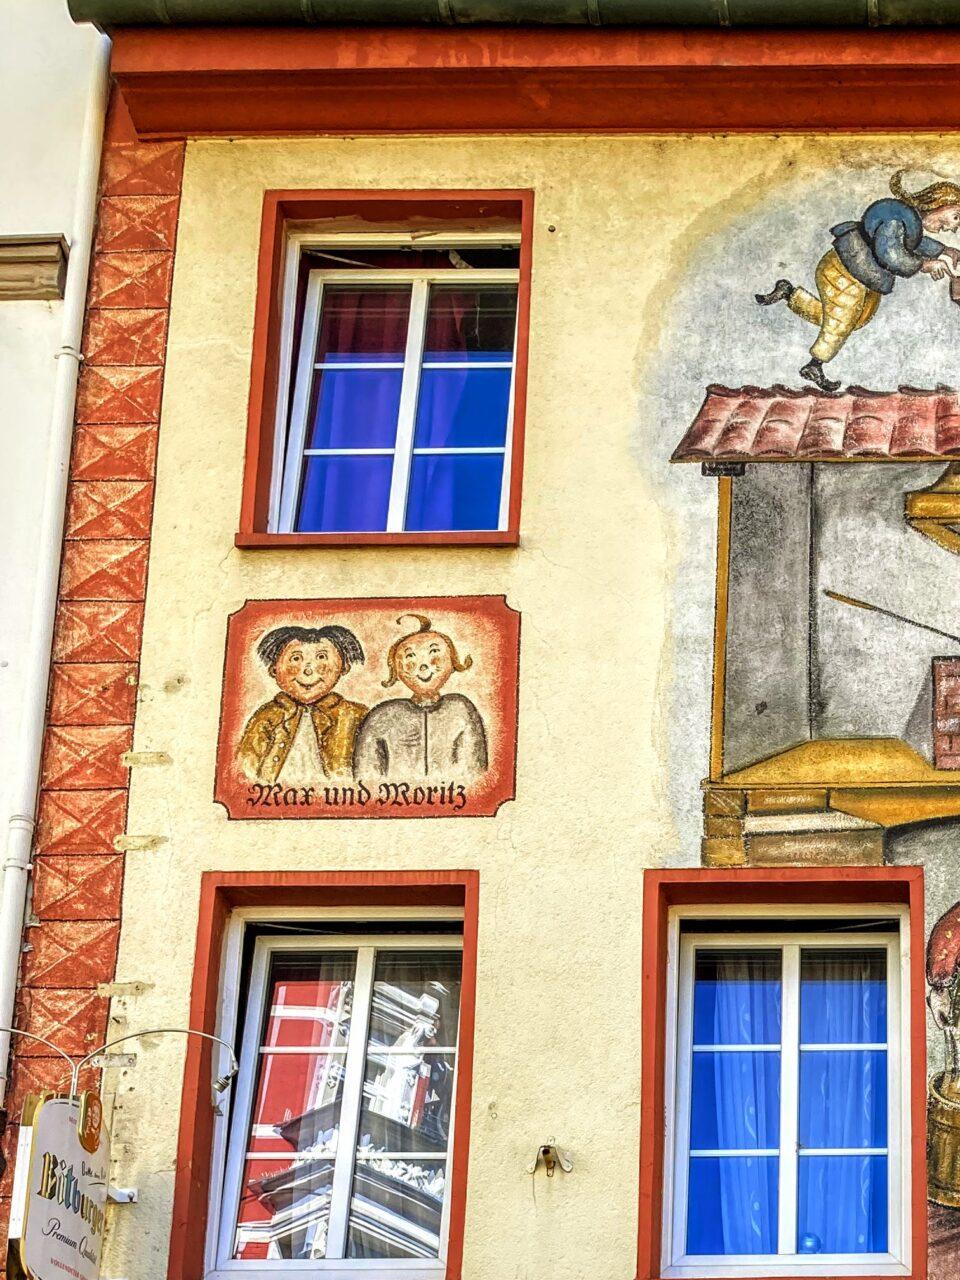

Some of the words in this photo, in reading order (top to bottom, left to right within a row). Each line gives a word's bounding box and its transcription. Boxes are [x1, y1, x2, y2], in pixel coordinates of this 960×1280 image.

[246, 783, 315, 806] Max
[323, 780, 371, 806] und
[375, 781, 467, 812] Moritz
[42, 1217, 78, 1249] Premium
